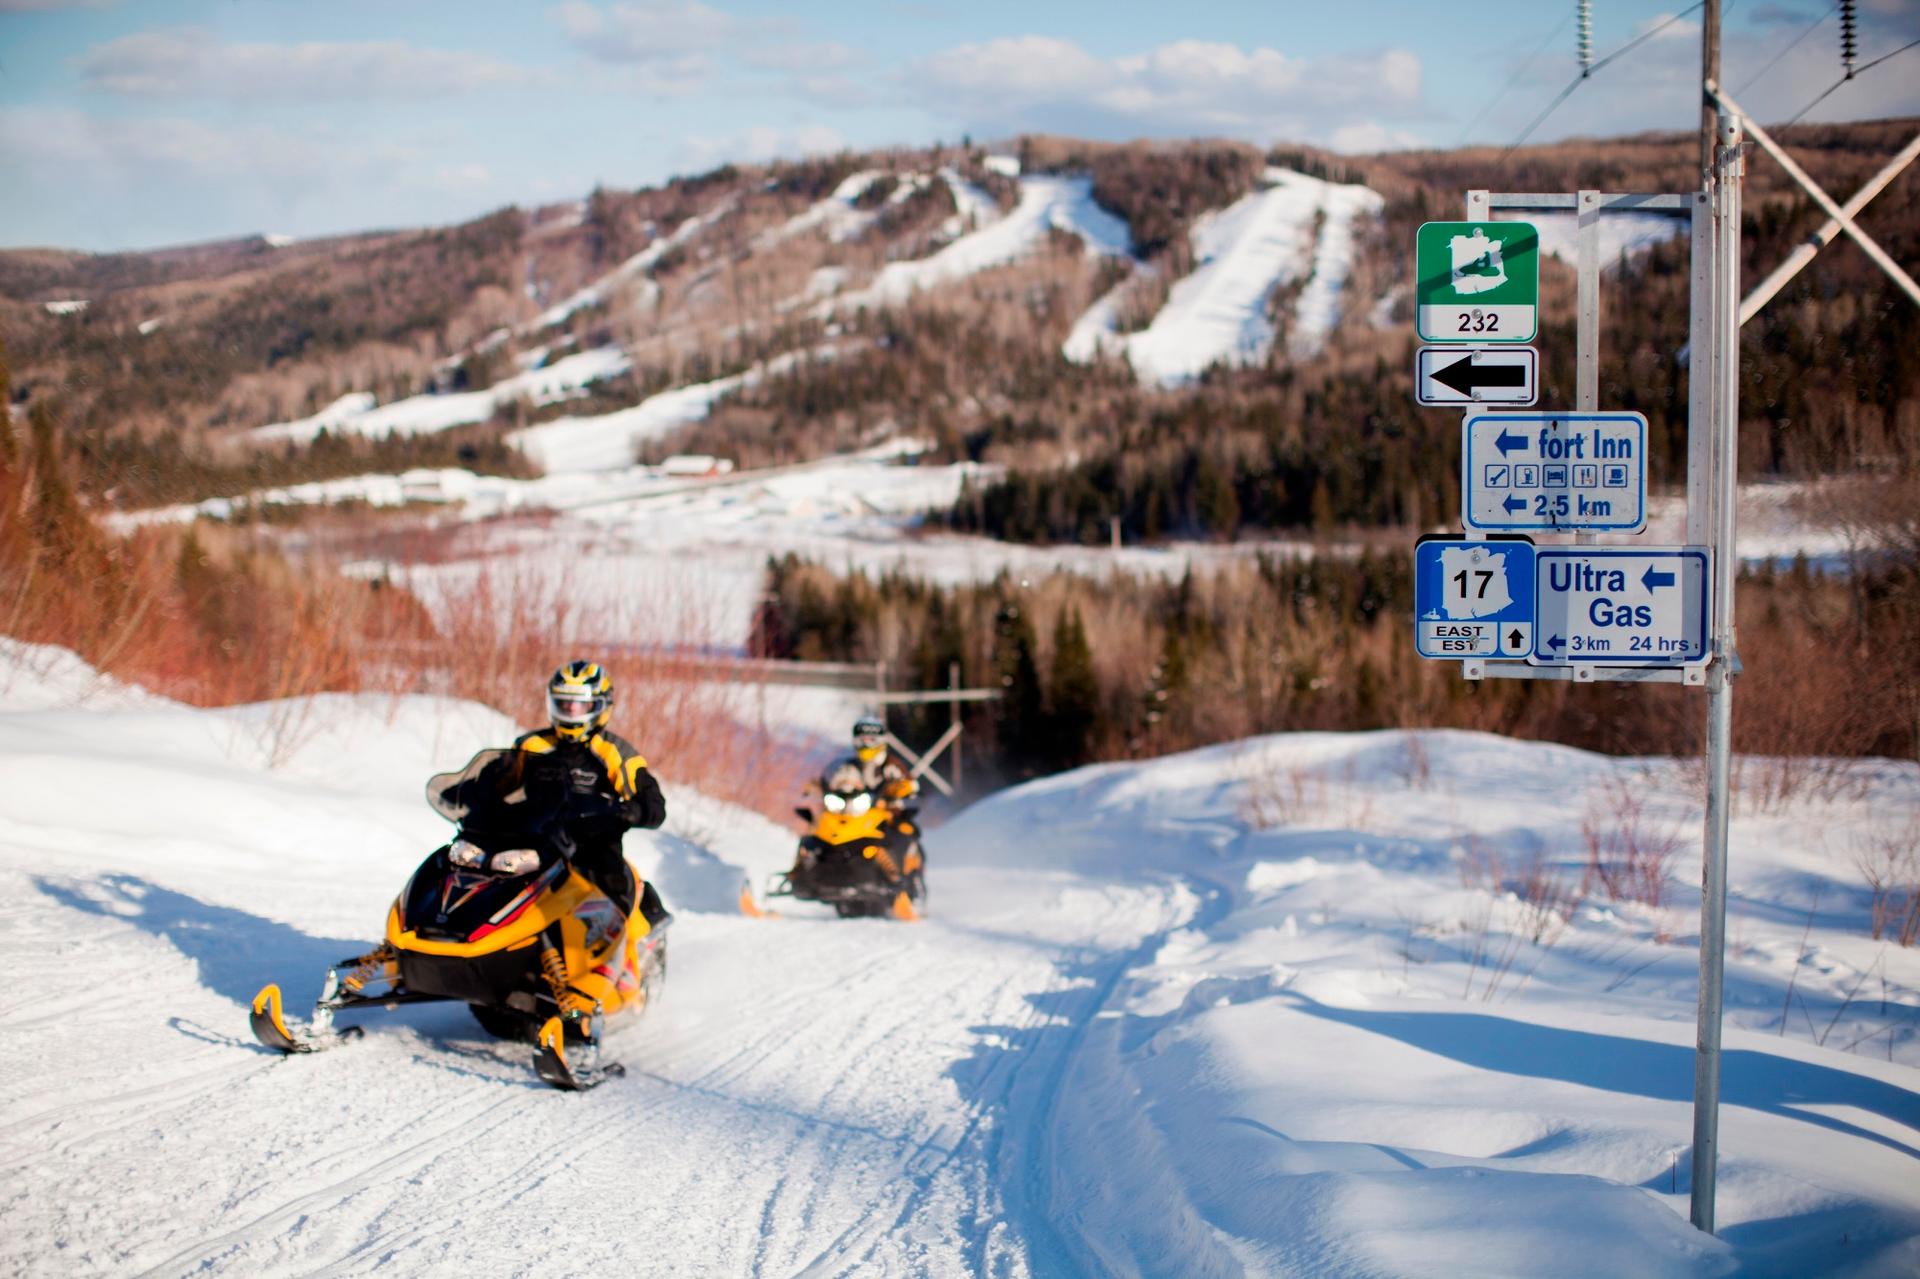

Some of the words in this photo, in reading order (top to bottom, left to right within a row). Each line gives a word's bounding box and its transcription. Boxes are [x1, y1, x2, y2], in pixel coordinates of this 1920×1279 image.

[1458, 313, 1499, 332] 232
[1539, 429, 1584, 459] fort
[1594, 429, 1632, 458] Inn
[1578, 495, 1611, 516] km
[1453, 570, 1494, 599] 17
[1550, 563, 1625, 592] Ultra
[1589, 598, 1652, 628] Gas
[1436, 626, 1484, 637] EAST
[1442, 640, 1475, 651] EST
[1571, 636, 1582, 651] 3
[1587, 636, 1610, 651] km
[1629, 636, 1652, 651] 24
[1658, 636, 1689, 651] hrs
